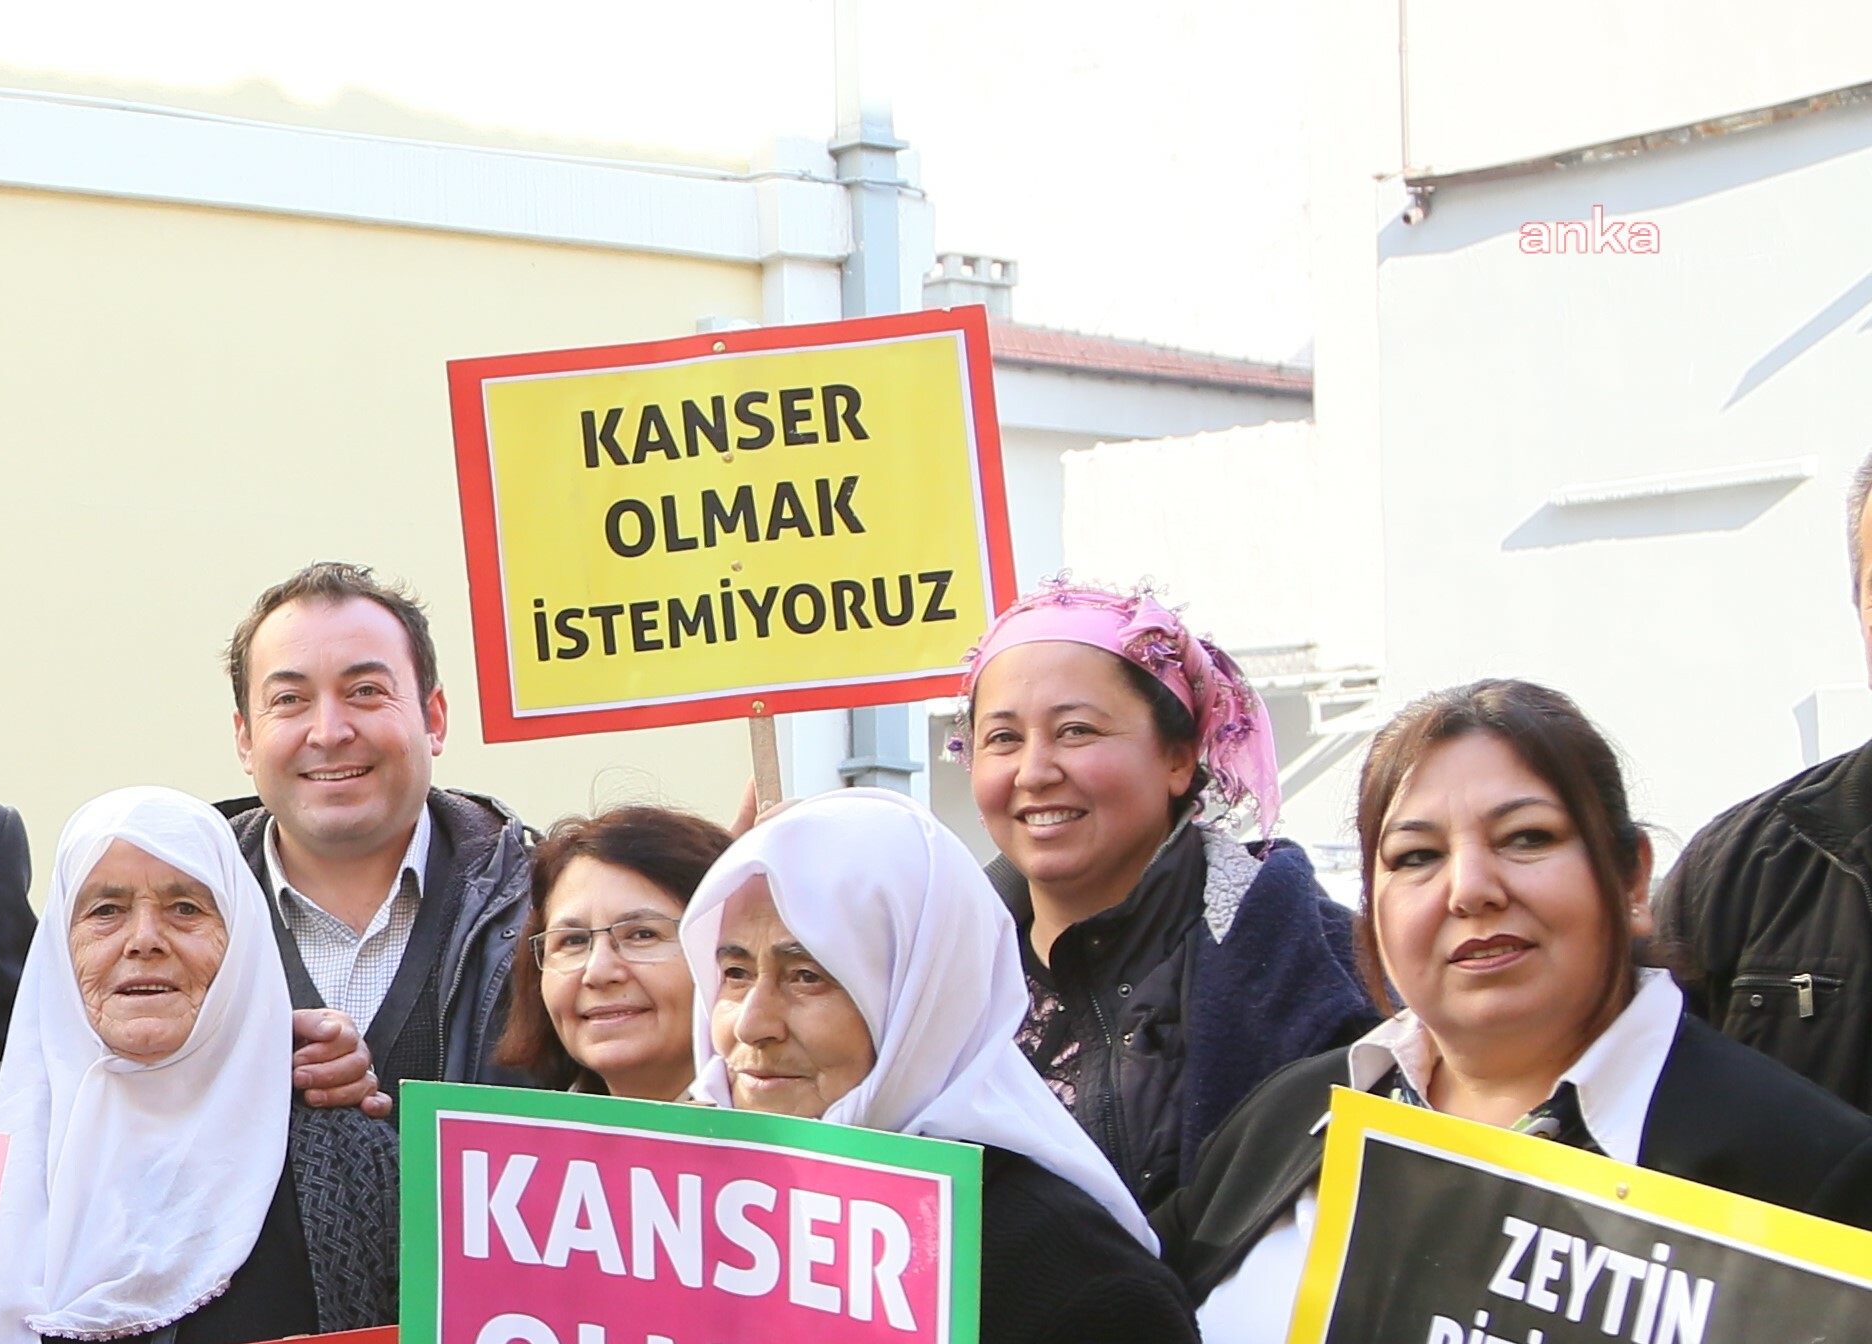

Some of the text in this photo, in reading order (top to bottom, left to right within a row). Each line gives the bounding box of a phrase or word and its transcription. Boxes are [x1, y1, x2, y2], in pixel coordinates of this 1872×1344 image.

[580, 384, 870, 468] KANSER
[604, 475, 866, 558] OLMAK
[534, 570, 956, 662] İSTEMİYORUZ
[462, 1150, 918, 1332] KANSER
